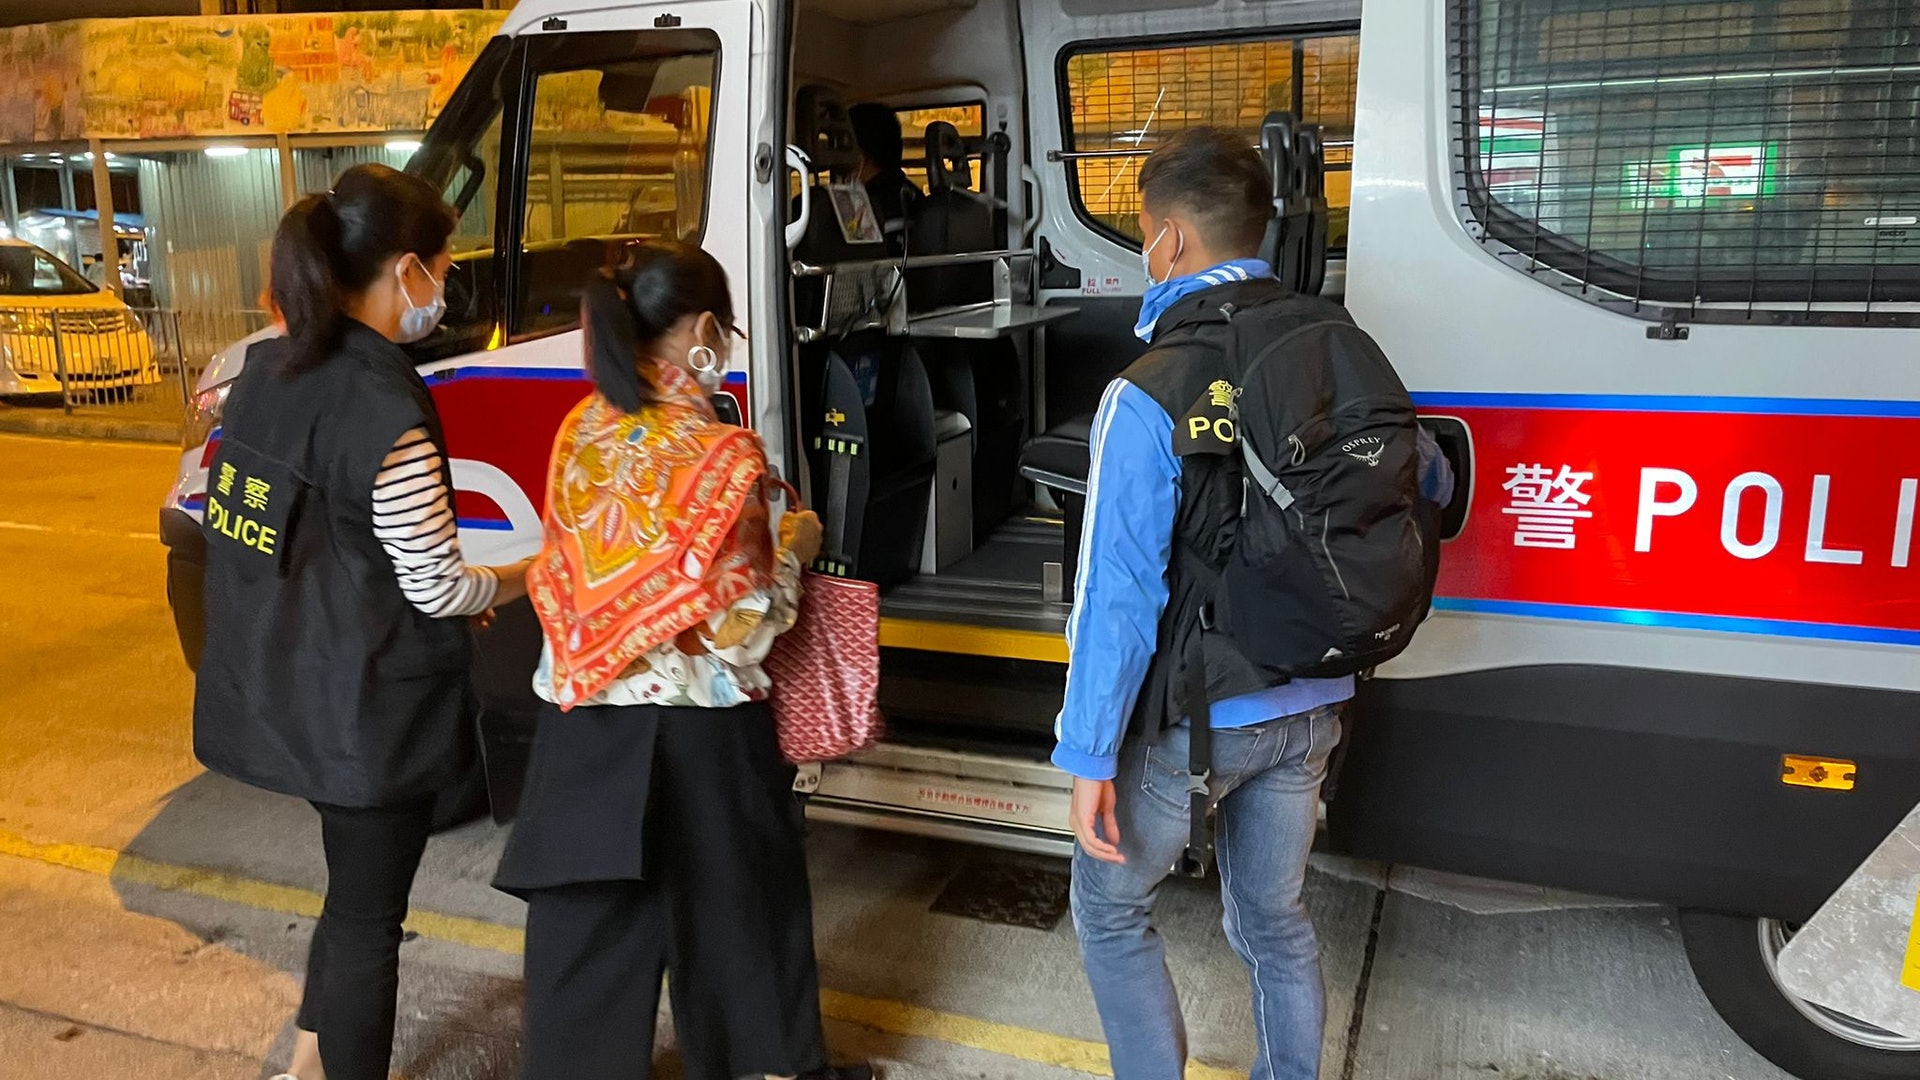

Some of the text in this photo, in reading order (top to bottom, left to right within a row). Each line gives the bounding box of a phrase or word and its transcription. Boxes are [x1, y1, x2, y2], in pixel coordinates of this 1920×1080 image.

[1188, 416, 1234, 443] PO
[1341, 436, 1381, 452] OSPREY
[207, 496, 278, 555] POLICE
[1501, 463, 1919, 568] 警 POLI
